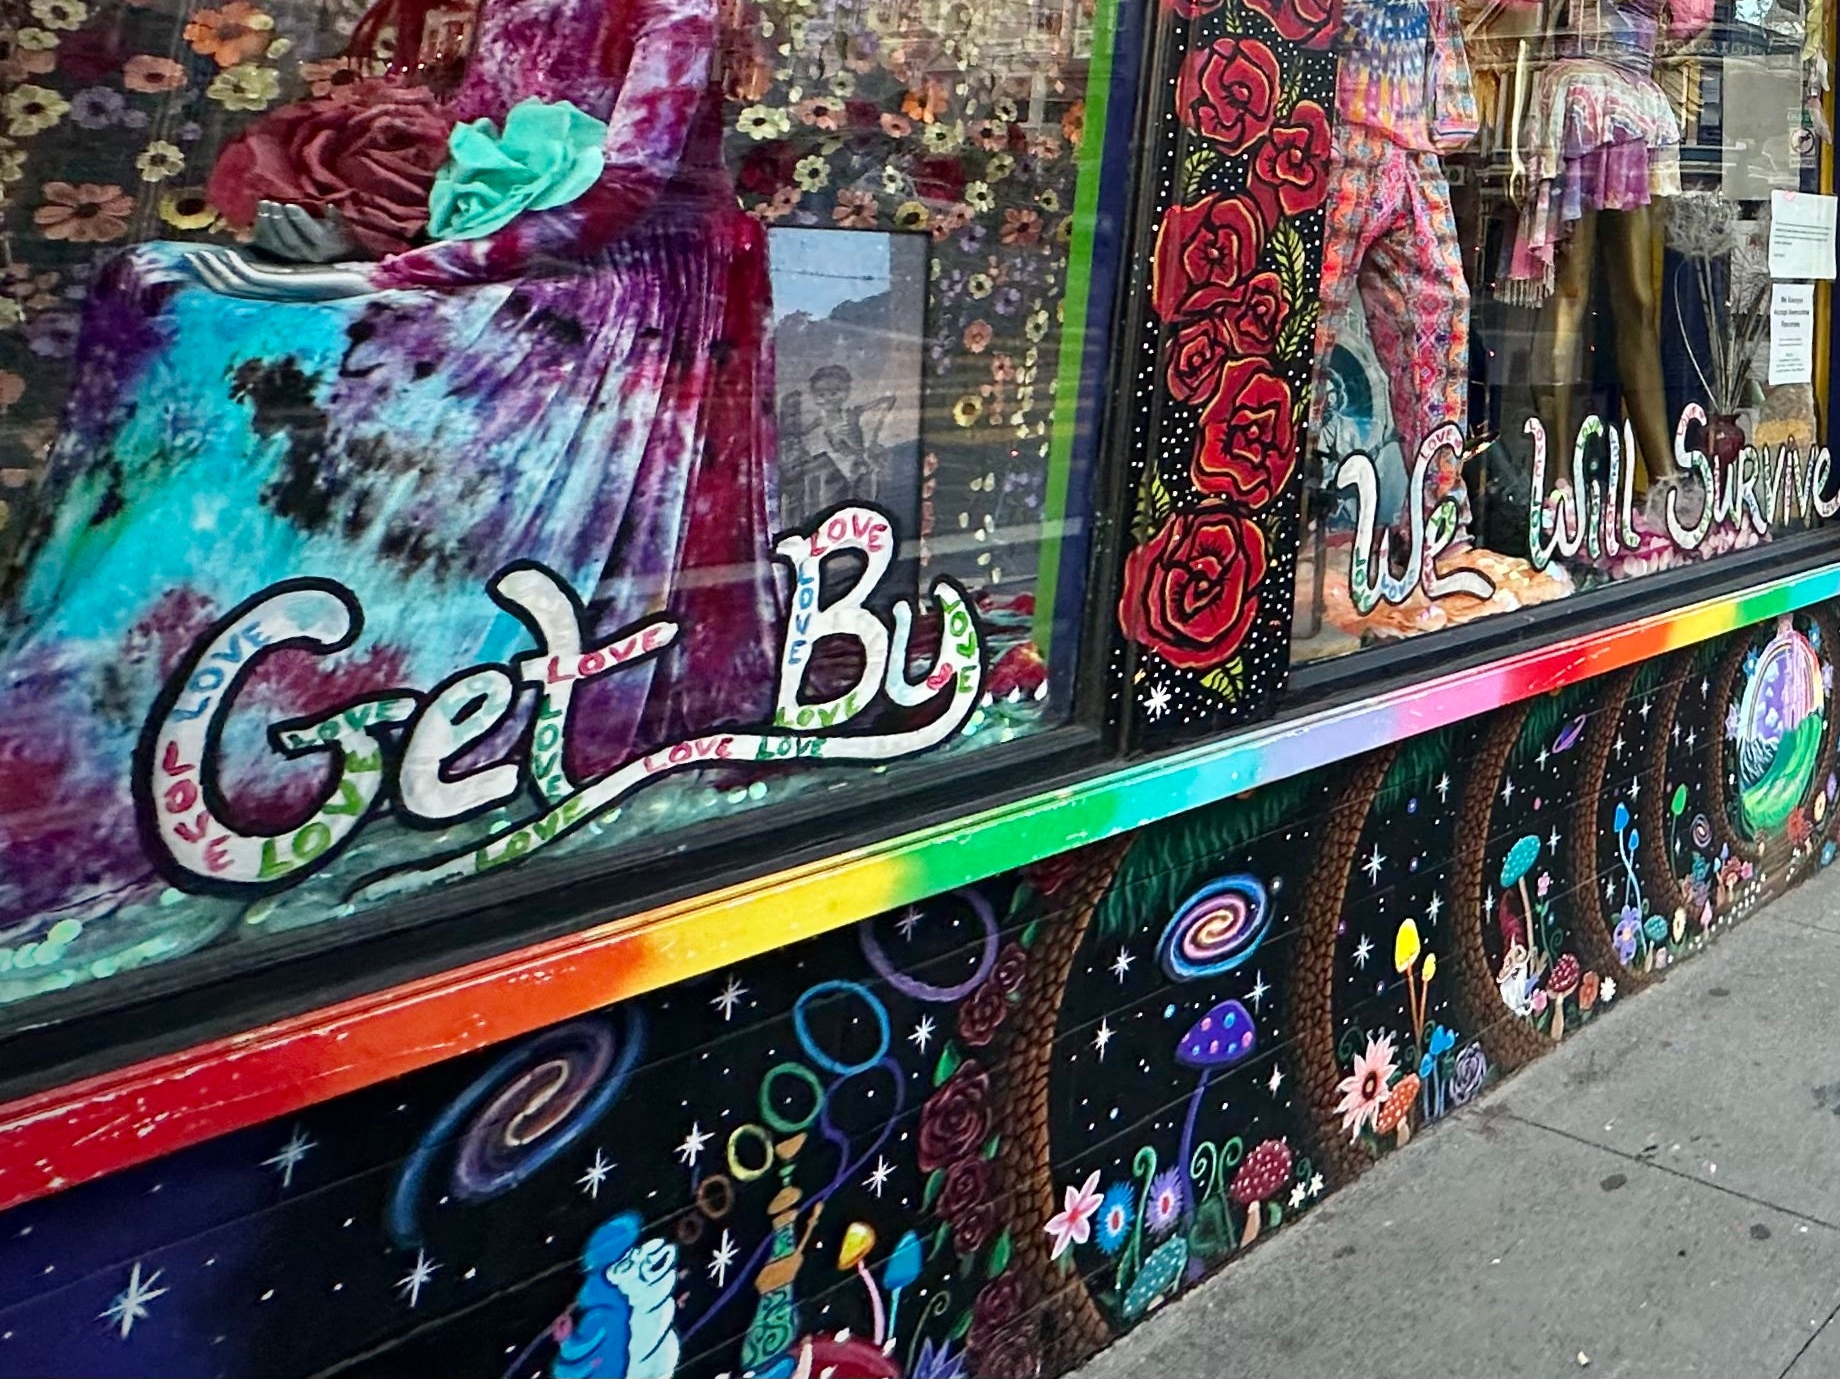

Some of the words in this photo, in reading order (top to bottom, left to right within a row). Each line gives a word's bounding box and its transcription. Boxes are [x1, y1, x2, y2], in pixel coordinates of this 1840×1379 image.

[1419, 427, 1454, 462] LOVE
[810, 513, 888, 558] LOVE
[787, 560, 816, 666] LOVE
[1353, 546, 1374, 610] LOVE
[170, 620, 275, 724] LOVE
[547, 625, 664, 685] LOVE
[938, 593, 979, 695] LOVE
[130, 557, 680, 898] Get
[770, 507, 987, 760] By
[286, 697, 405, 750] LOVE
[773, 691, 860, 728] LOVE
[535, 693, 564, 804] LOVE
[643, 735, 734, 772] LOVE
[755, 736, 828, 761] LOVE
[160, 739, 237, 874] LOVE
[255, 747, 384, 880] LOVE
[475, 794, 591, 873] LOVE
